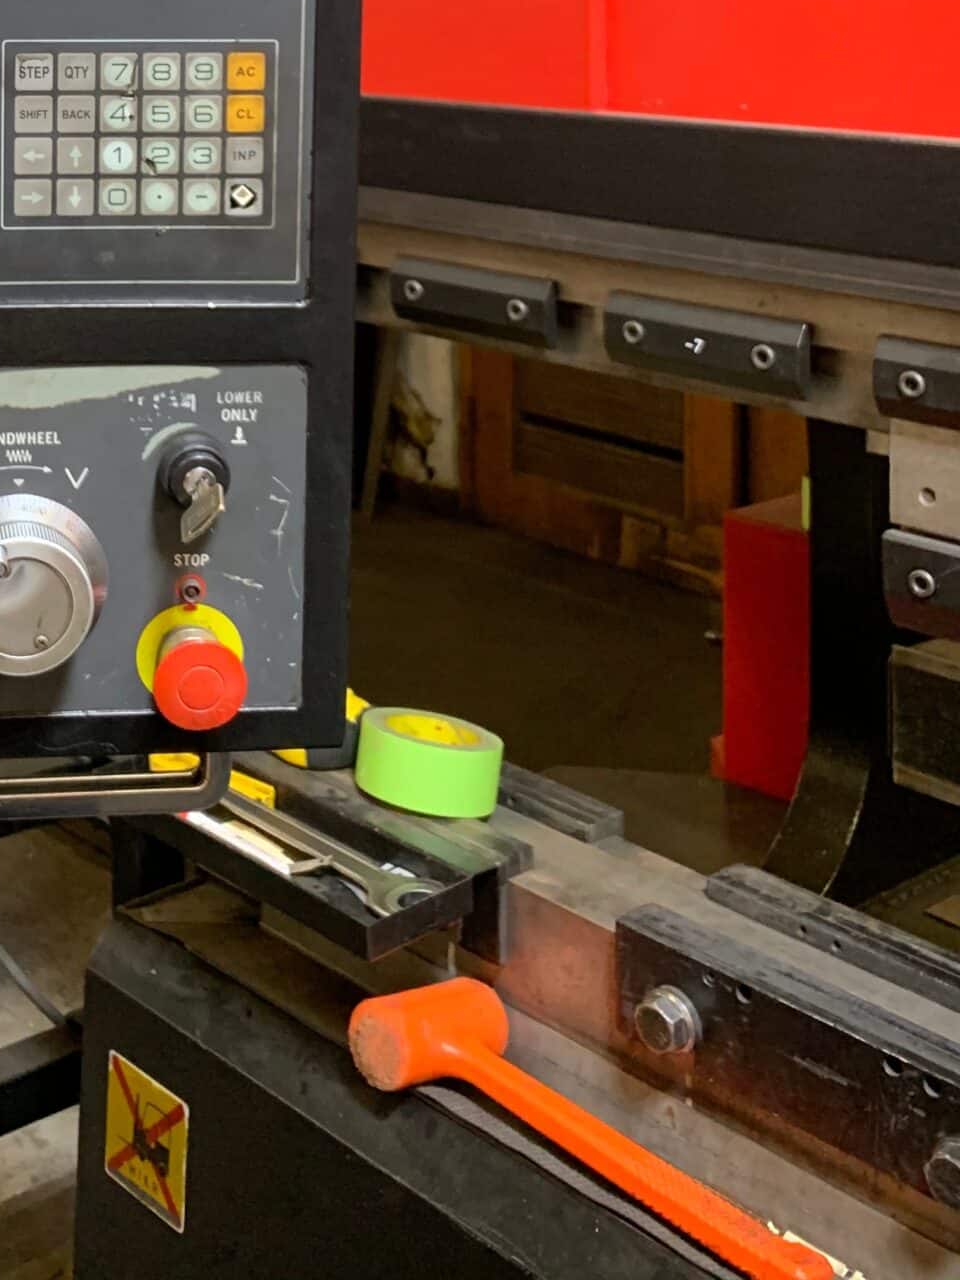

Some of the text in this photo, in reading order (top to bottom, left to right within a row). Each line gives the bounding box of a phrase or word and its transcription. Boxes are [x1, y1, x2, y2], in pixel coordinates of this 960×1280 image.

[19, 66, 50, 79] STEP
[64, 66, 89, 78] QTY
[111, 63, 129, 81] 7
[152, 63, 171, 81] 8
[194, 63, 214, 81] 9
[235, 67, 256, 77] AC
[19, 110, 48, 120] SHIFT
[62, 110, 91, 120] BACK
[109, 103, 128, 122] 4
[151, 105, 171, 123] 5
[193, 105, 213, 122] 6
[236, 108, 255, 120] CL
[112, 146, 122, 164] 1
[150, 146, 170, 164] 2
[193, 146, 212, 164] 3
[232, 150, 257, 160] INP
[216, 391, 264, 404] LOWER
[221, 408, 258, 422] ONLY
[173, 554, 210, 566] STOP
